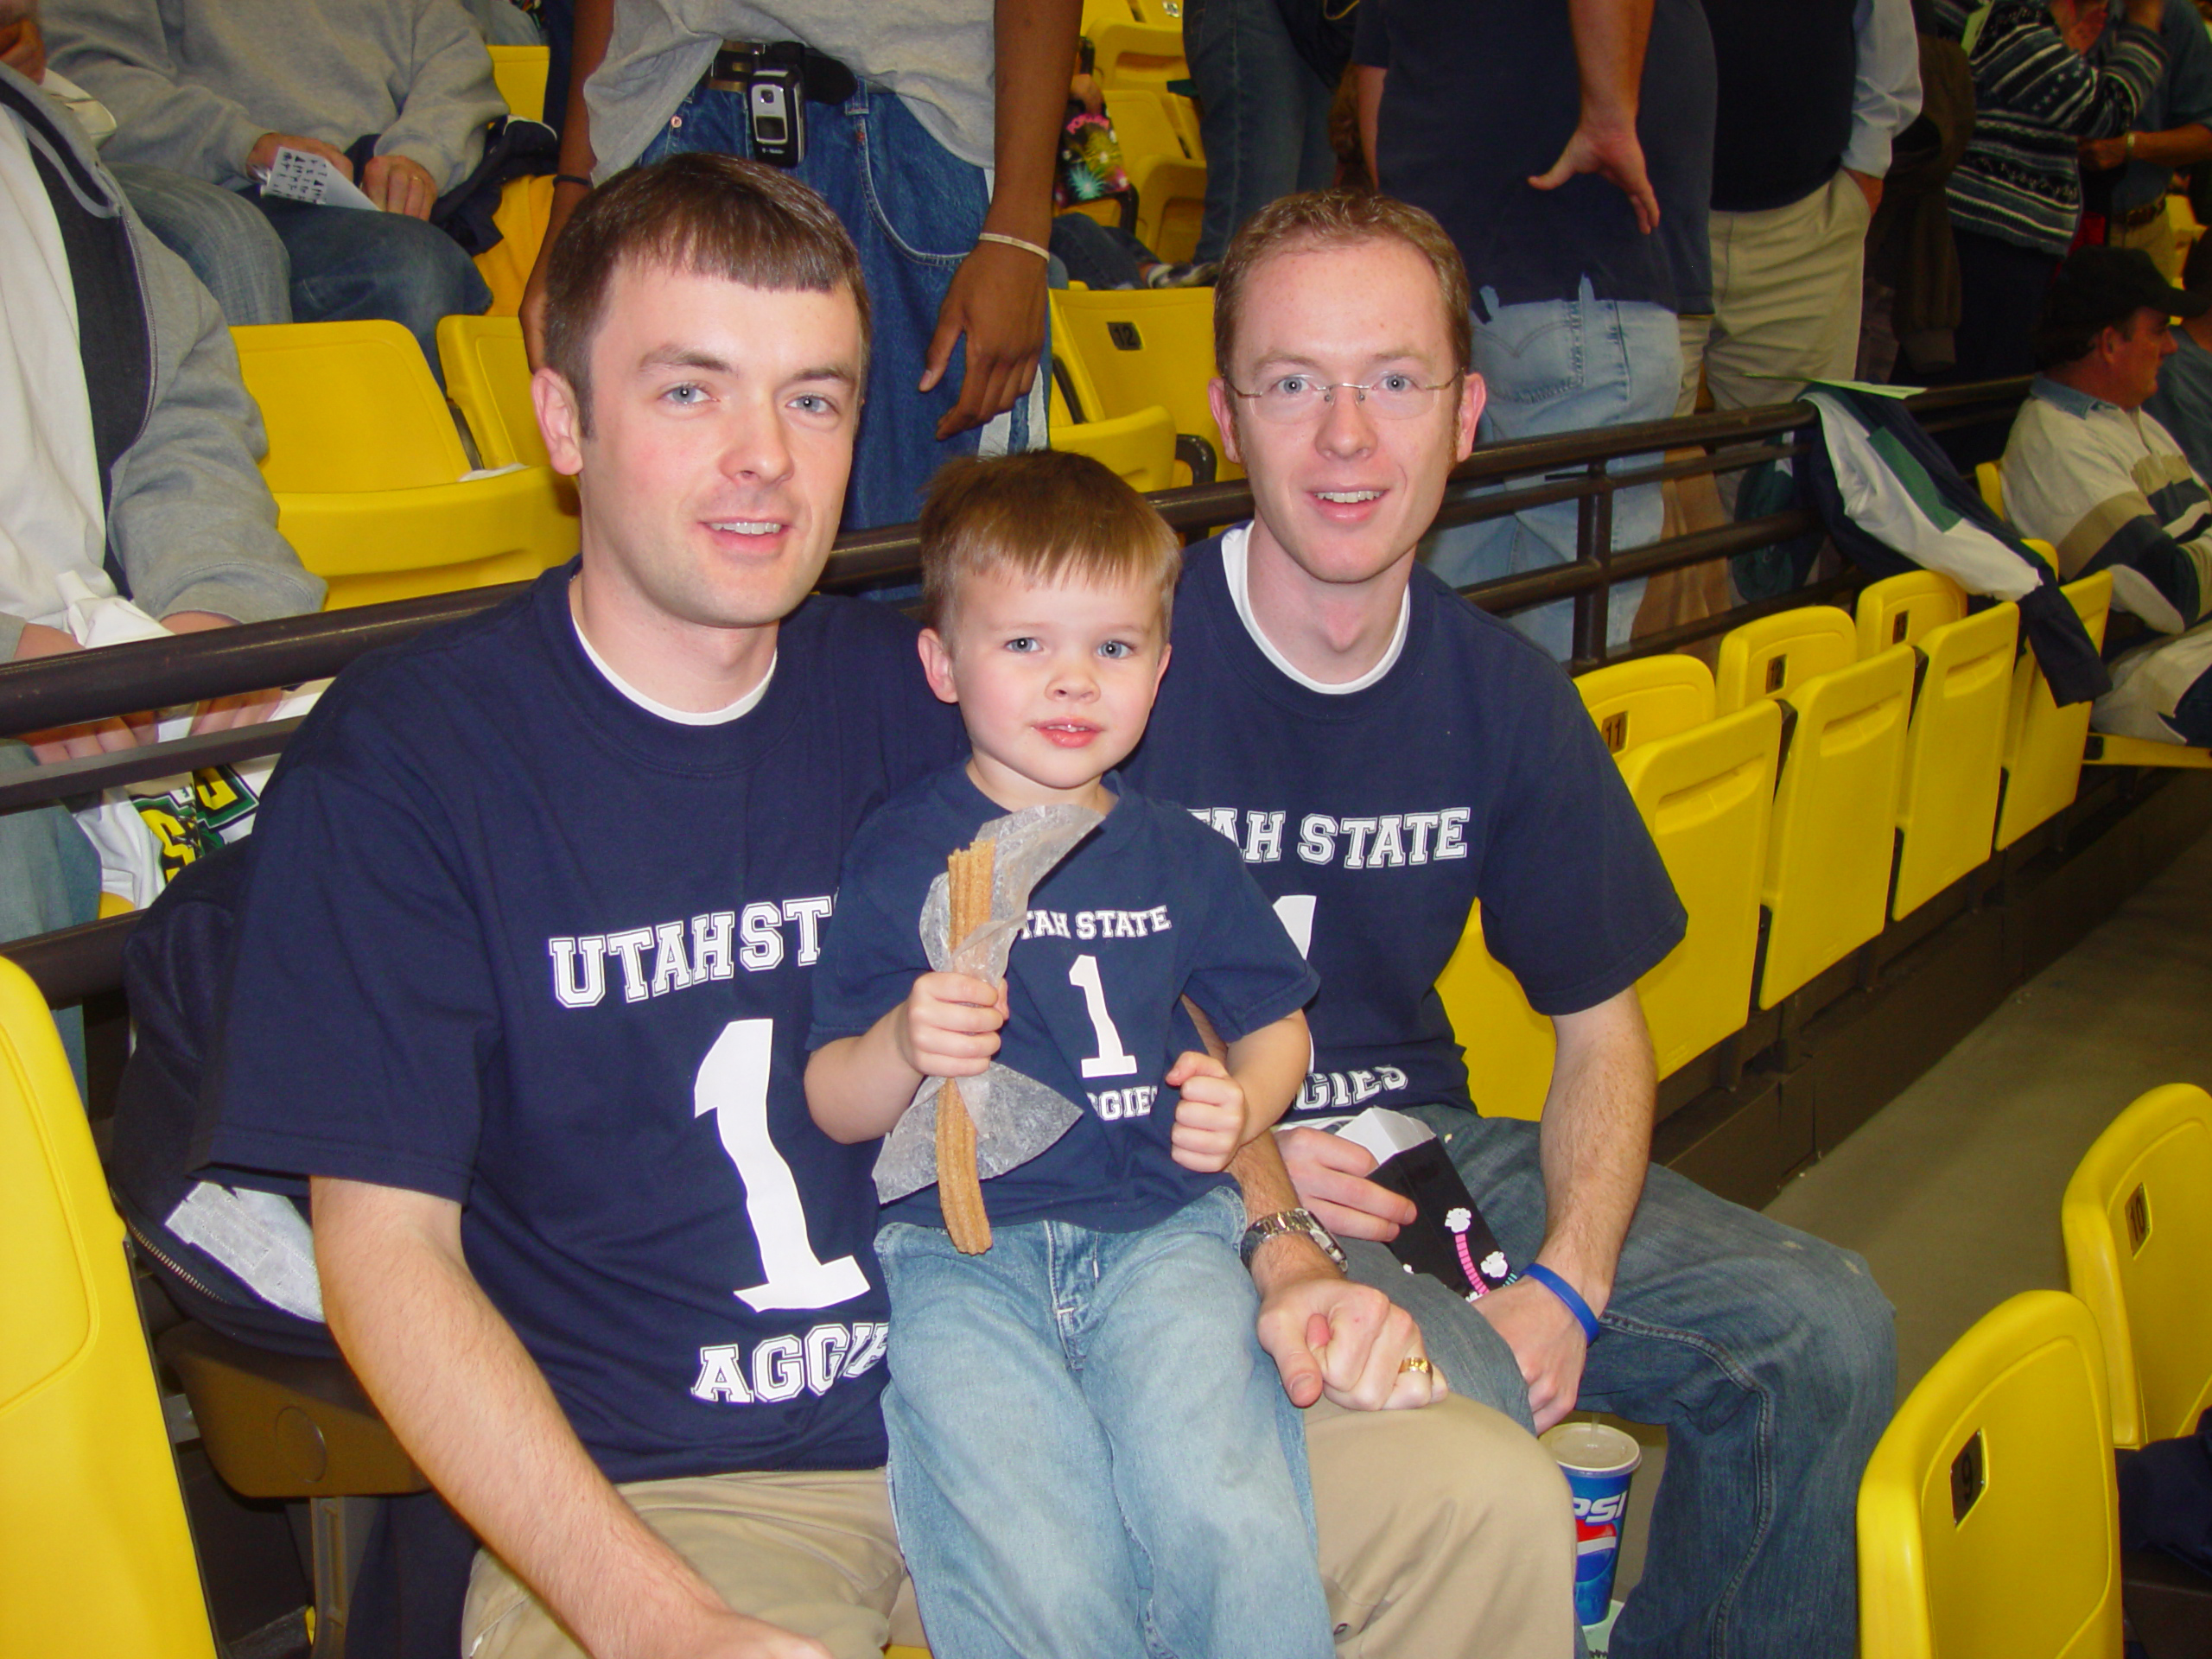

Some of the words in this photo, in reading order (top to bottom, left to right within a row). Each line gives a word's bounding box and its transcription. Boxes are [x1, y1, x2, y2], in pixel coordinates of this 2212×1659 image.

[1113, 327, 1141, 346] 12
[1770, 660, 1783, 688] 12
[1605, 718, 1621, 748] 11
[1297, 807, 1471, 869] STATE
[1021, 910, 1071, 939] TAH
[1075, 905, 1173, 940] STATE
[549, 911, 735, 1008] UTAH
[740, 895, 839, 972] ST
[1069, 954, 1138, 1078] 1
[694, 1018, 871, 1313] 1
[2130, 1197, 2145, 1242] 10
[690, 1322, 889, 1403] AGGIE
[1961, 1452, 1974, 1502] 9
